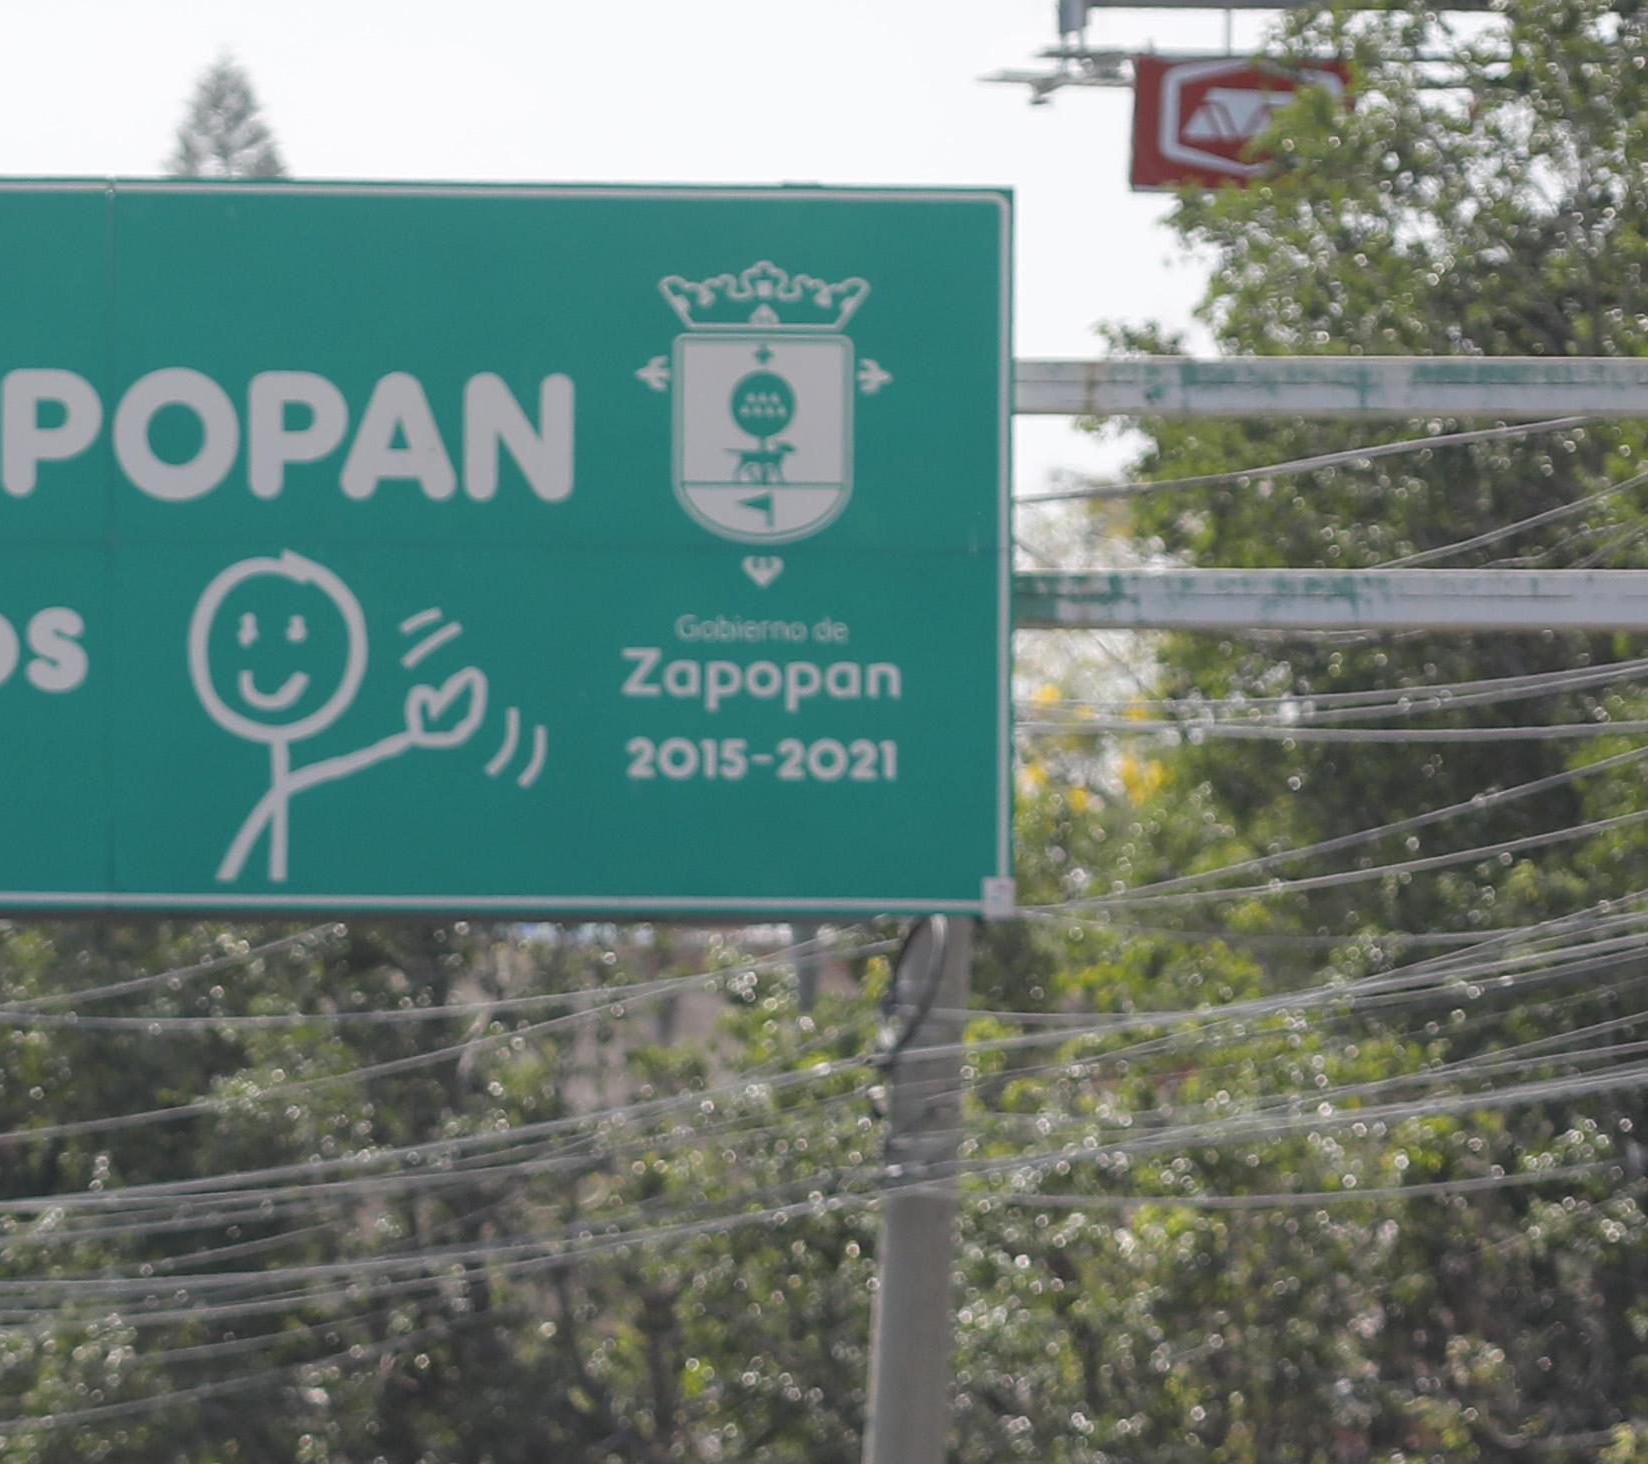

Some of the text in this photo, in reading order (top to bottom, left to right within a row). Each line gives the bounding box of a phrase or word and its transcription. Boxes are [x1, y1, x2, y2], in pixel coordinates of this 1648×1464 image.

[675, 613, 849, 642] Gobierno de
[620, 647, 902, 713] Zapopan
[626, 736, 898, 782] 2015-2021
